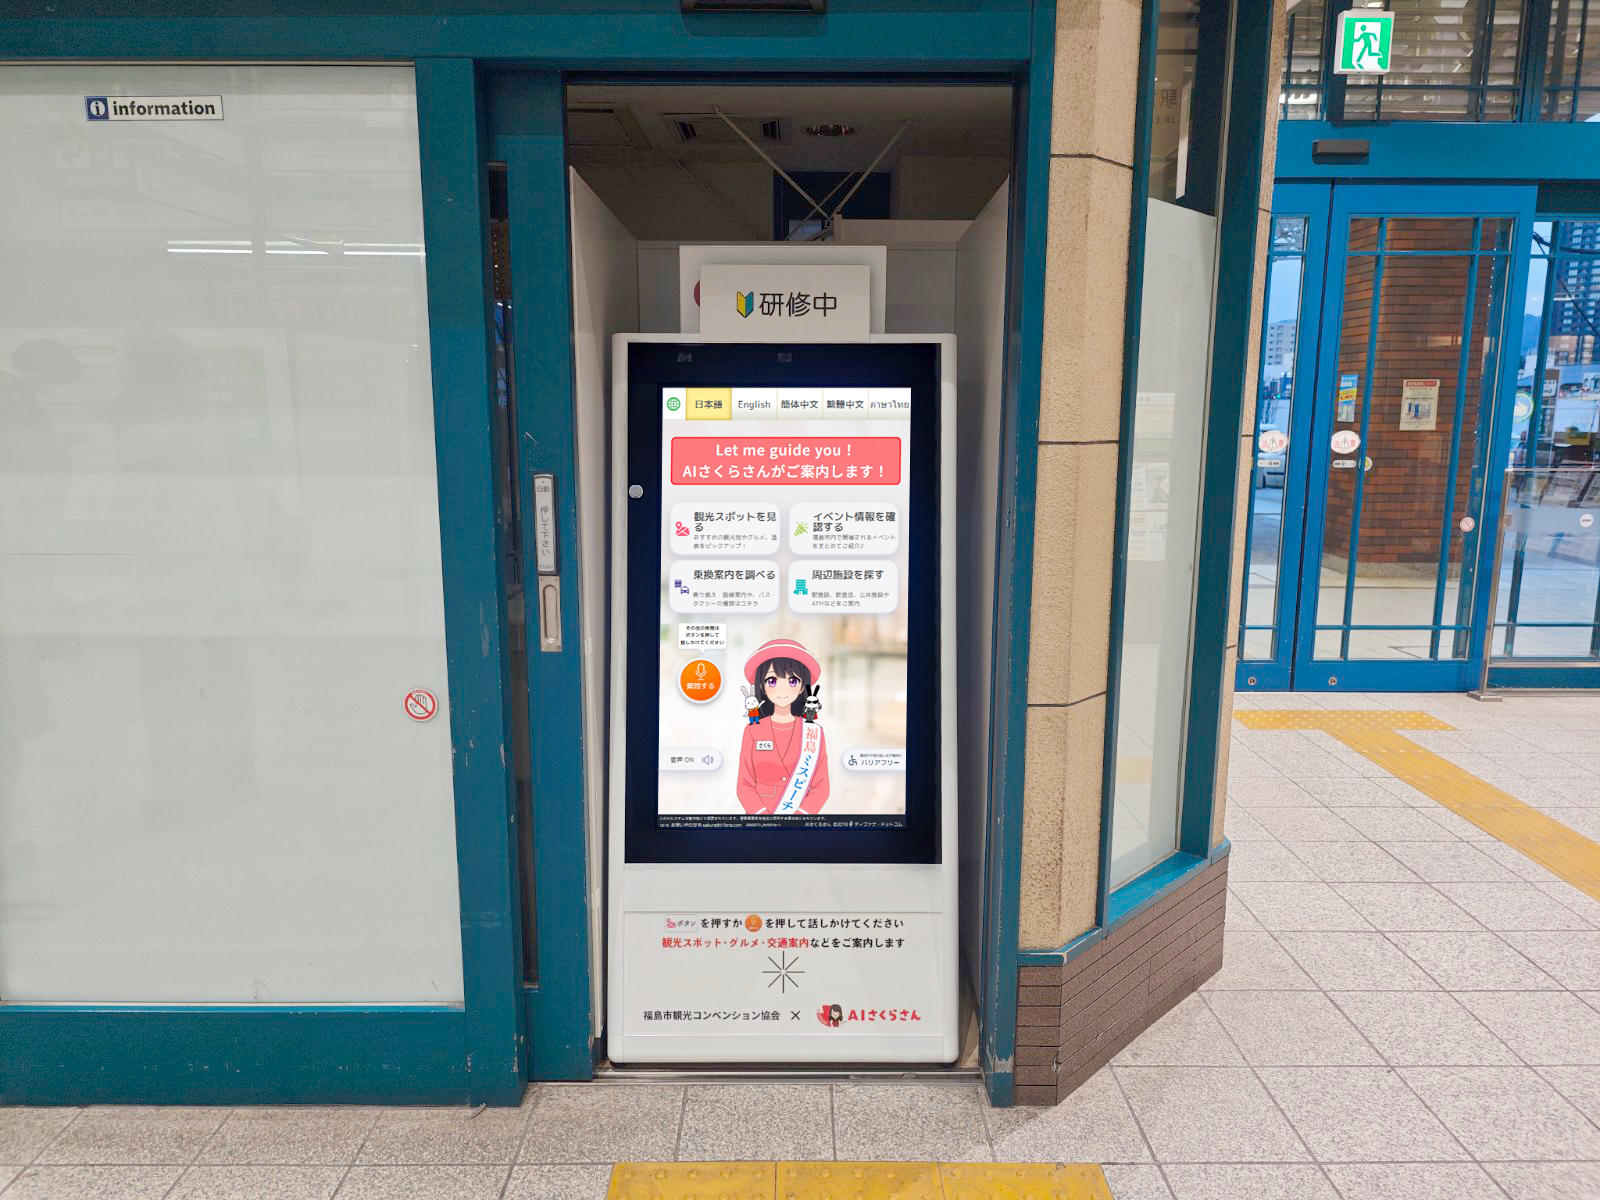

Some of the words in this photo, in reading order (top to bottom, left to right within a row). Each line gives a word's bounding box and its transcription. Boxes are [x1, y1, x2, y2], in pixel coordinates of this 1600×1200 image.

[113, 100, 216, 116] information
[758, 291, 838, 318] 研修中
[695, 400, 723, 410] 日本語
[738, 399, 771, 411] English
[869, 399, 910, 410] ภาษาไทย
[715, 444, 739, 457] Let
[743, 447, 765, 457] me
[769, 444, 811, 460] guide
[693, 511, 777, 522] 観光スポットを見
[813, 511, 896, 522] イベント情報を確
[694, 522, 704, 532] る
[812, 522, 844, 532] 認する
[693, 570, 776, 580] 乗換案内を調べる
[811, 570, 885, 580] 周辺施設を探す
[686, 682, 715, 690] 質問する
[700, 918, 743, 929] を押すか
[764, 918, 905, 930] を押して話しかけてください
[643, 1010, 781, 1021] 福島市観光コンベンション協会
[847, 1009, 922, 1022] AIさくらさん
